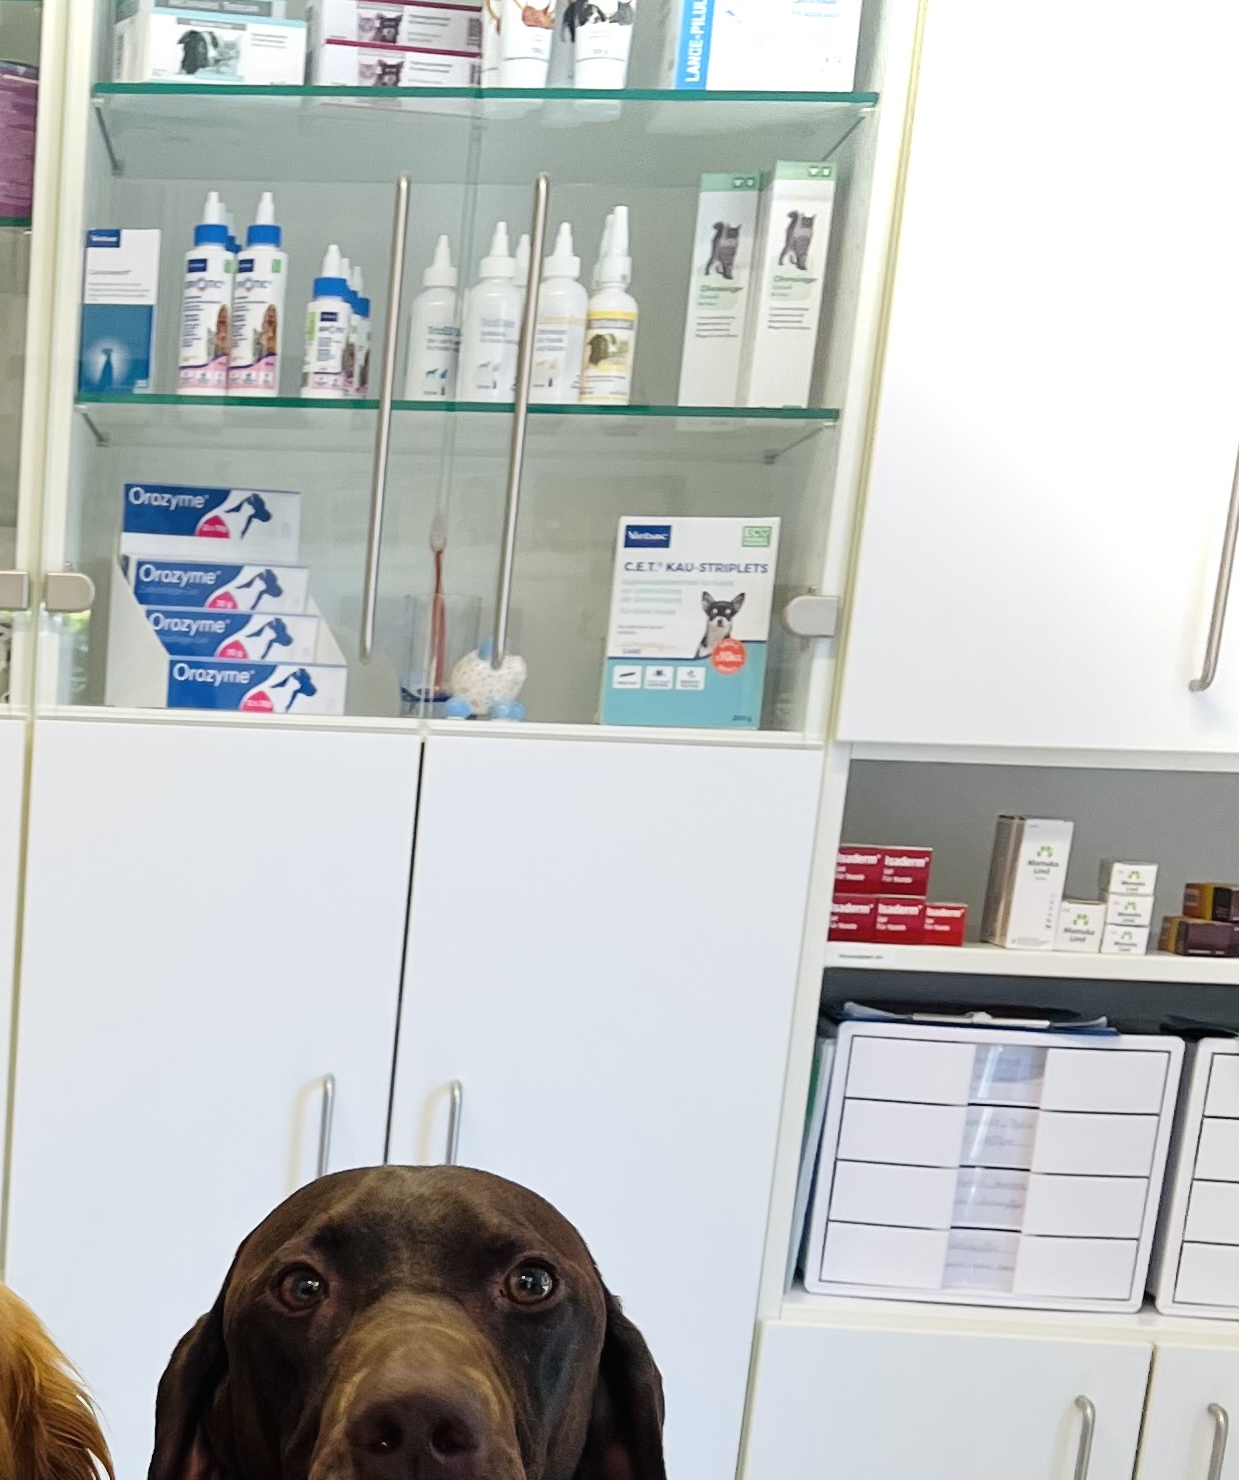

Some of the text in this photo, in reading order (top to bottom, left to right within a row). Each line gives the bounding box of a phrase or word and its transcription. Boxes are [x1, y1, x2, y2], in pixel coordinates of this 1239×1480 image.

[128, 486, 205, 510] Orozyme
[138, 564, 217, 587] Orozyme
[665, 562, 769, 574] KAU-STRIPLETS
[148, 612, 226, 636] Orozyme
[172, 663, 250, 686] Orozyme
